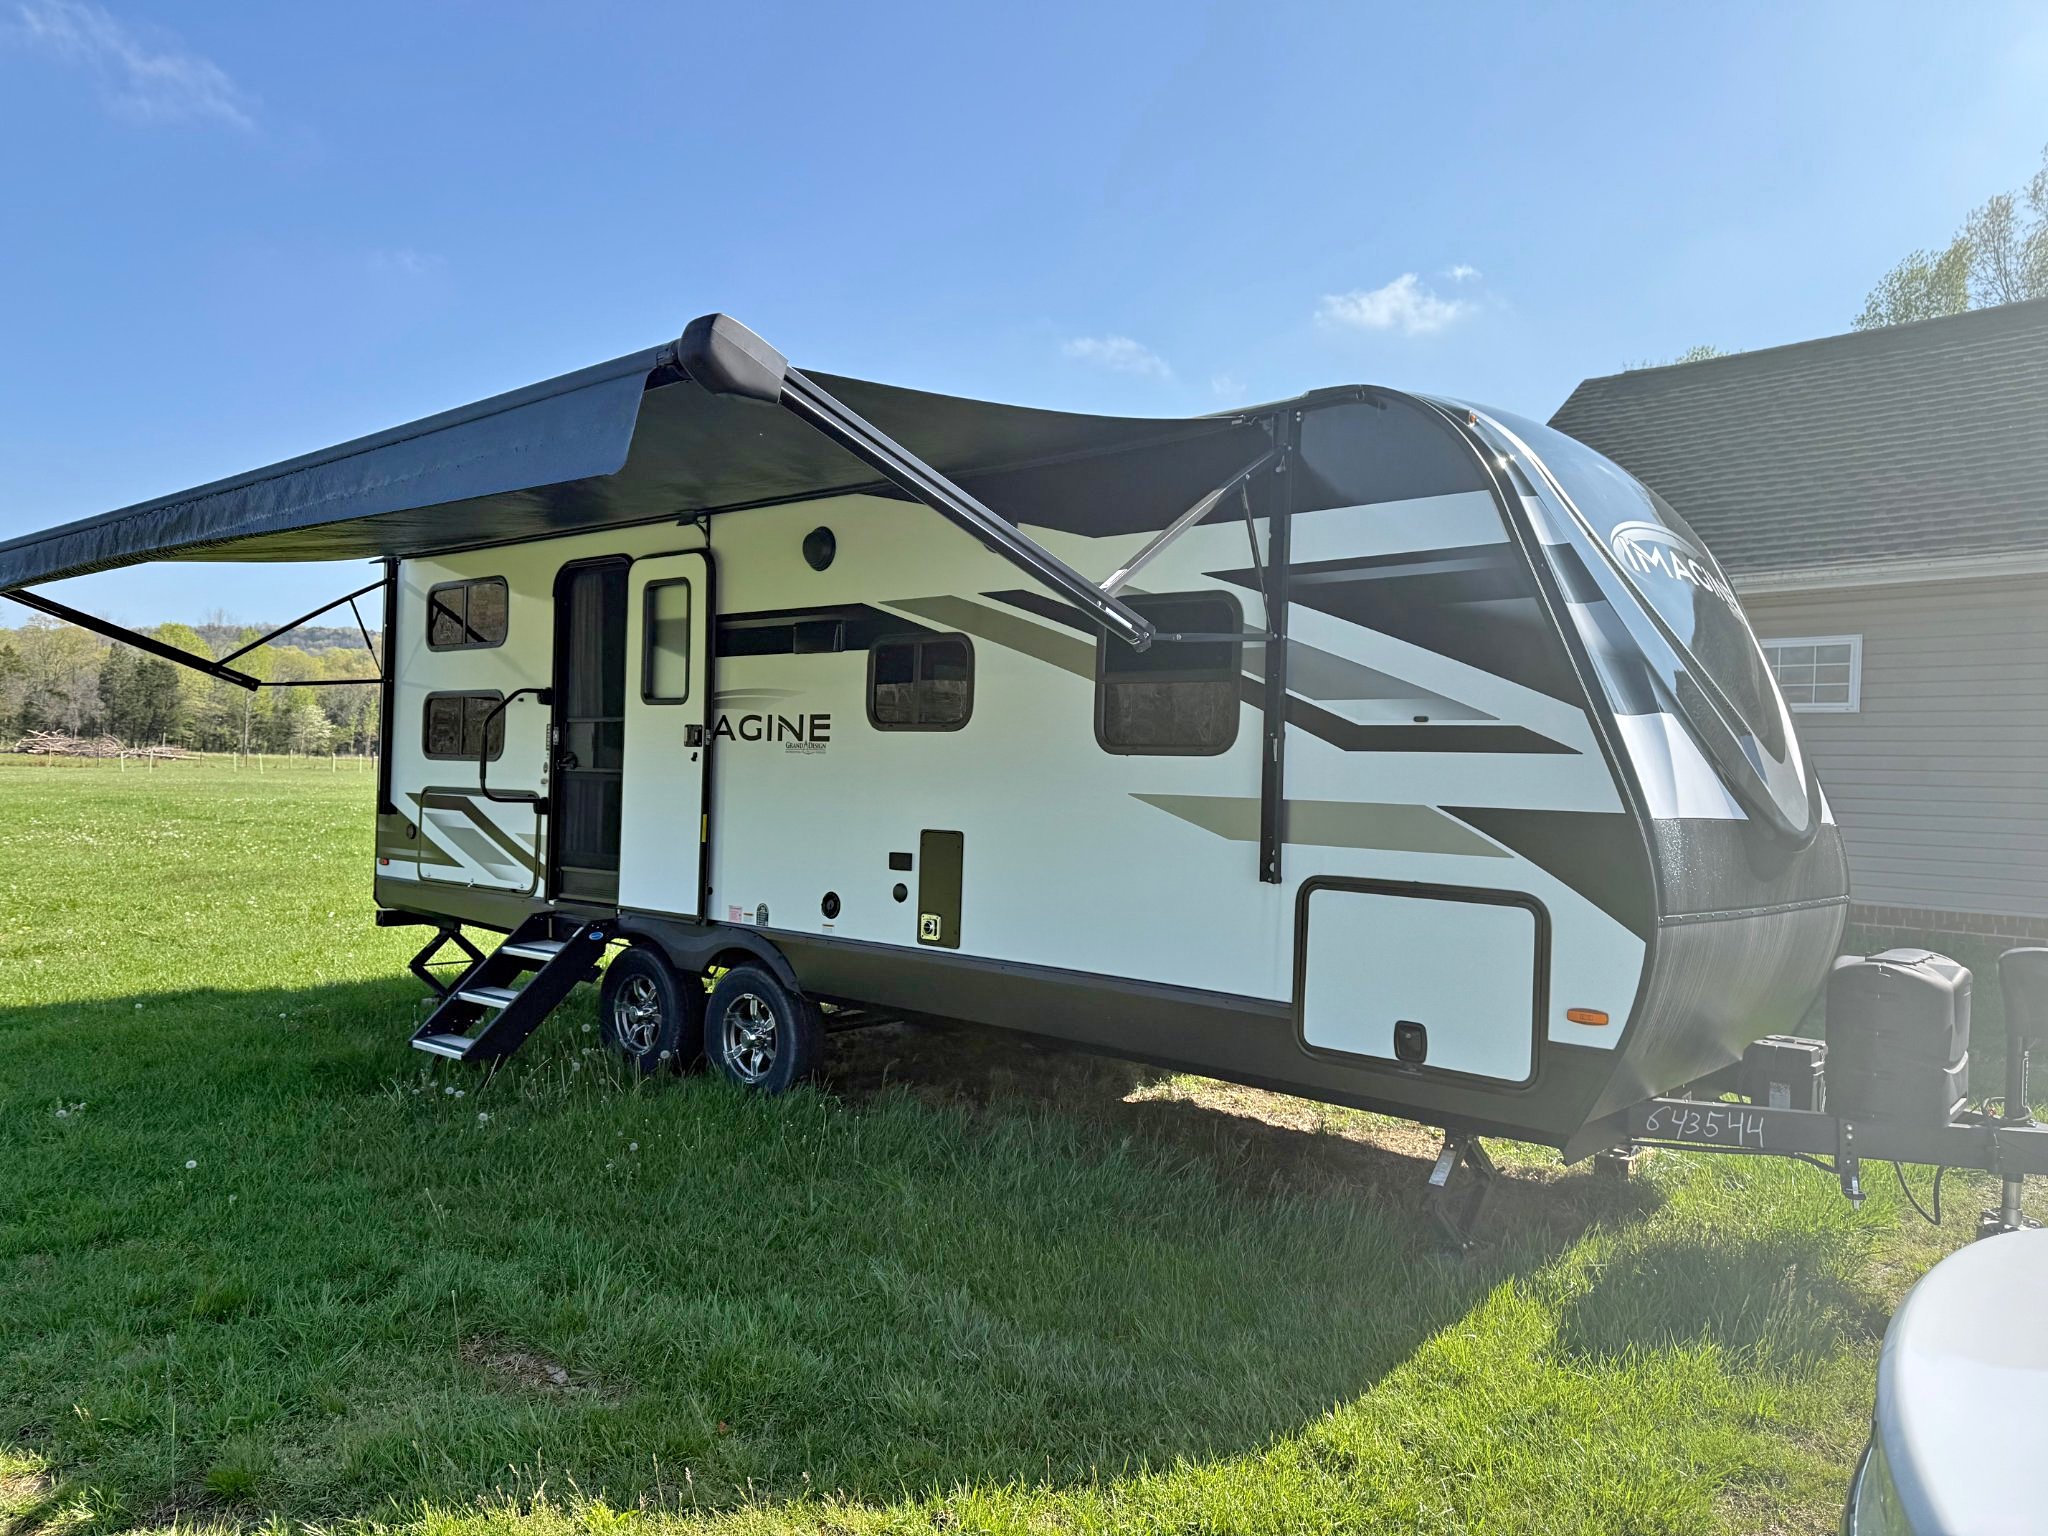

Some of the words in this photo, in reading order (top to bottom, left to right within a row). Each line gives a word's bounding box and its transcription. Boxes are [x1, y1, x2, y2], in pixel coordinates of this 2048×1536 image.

[712, 714, 831, 742] AGINE
[785, 741, 804, 749] GRAND
[808, 741, 827, 749] DESIGN
[1646, 1106, 1764, 1148] 643544
